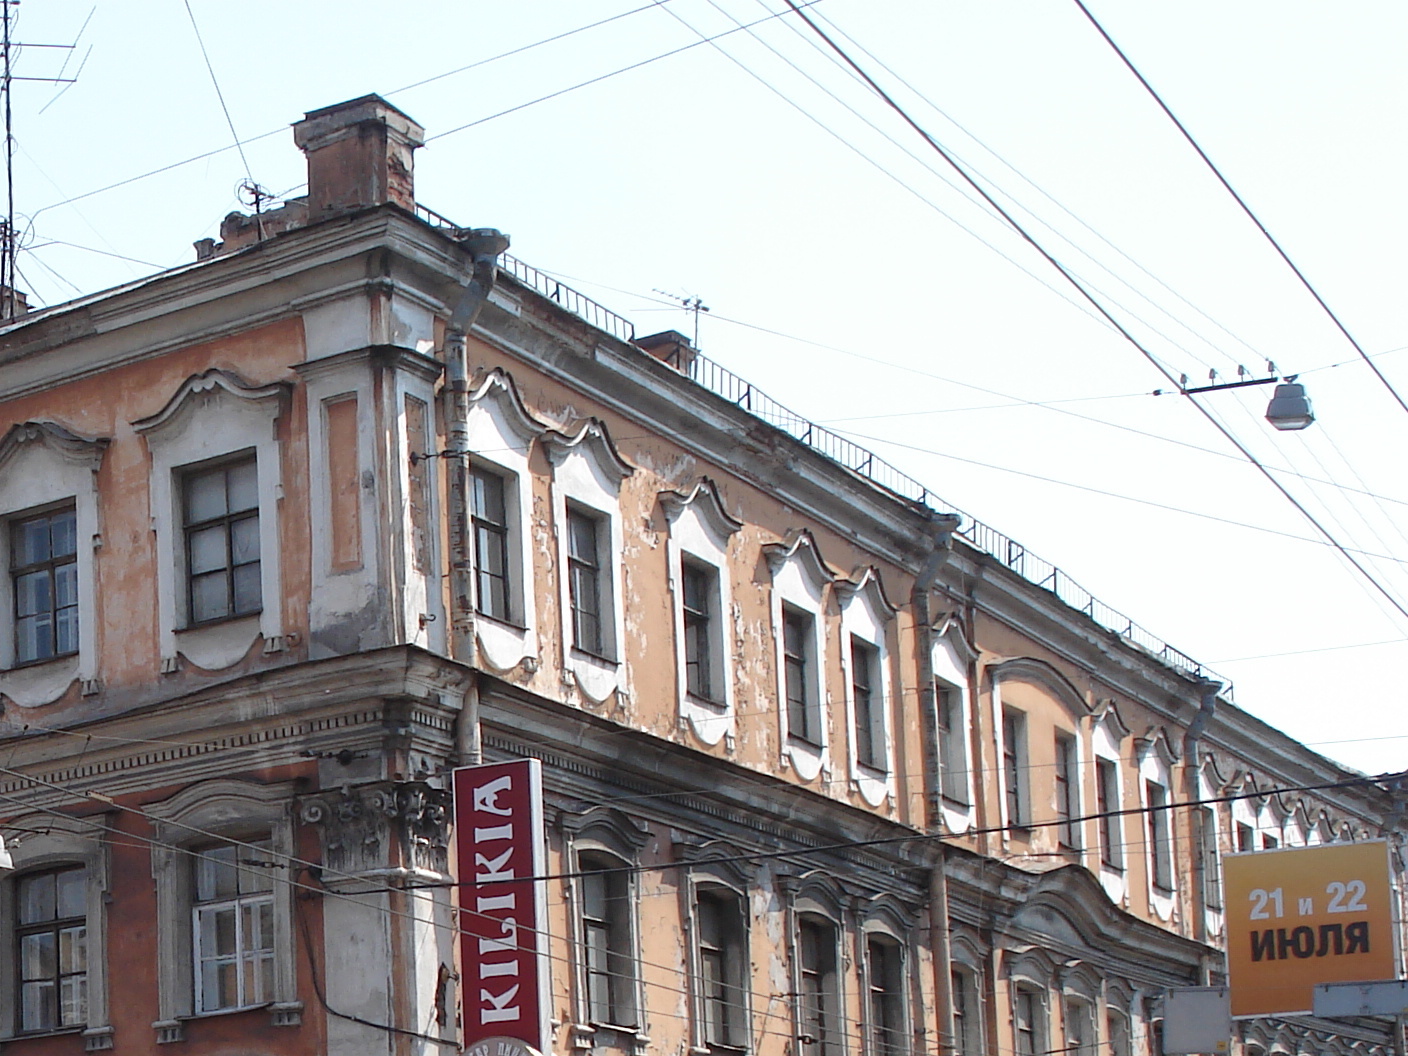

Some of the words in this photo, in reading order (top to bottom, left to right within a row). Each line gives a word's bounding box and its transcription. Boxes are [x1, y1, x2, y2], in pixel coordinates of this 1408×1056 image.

[473, 775, 520, 1025] KILIKIA
[1249, 888, 1284, 920] 21
[1298, 897, 1313, 916] и
[1326, 880, 1368, 913] 22
[1250, 921, 1370, 962] ИЮЛЯ
